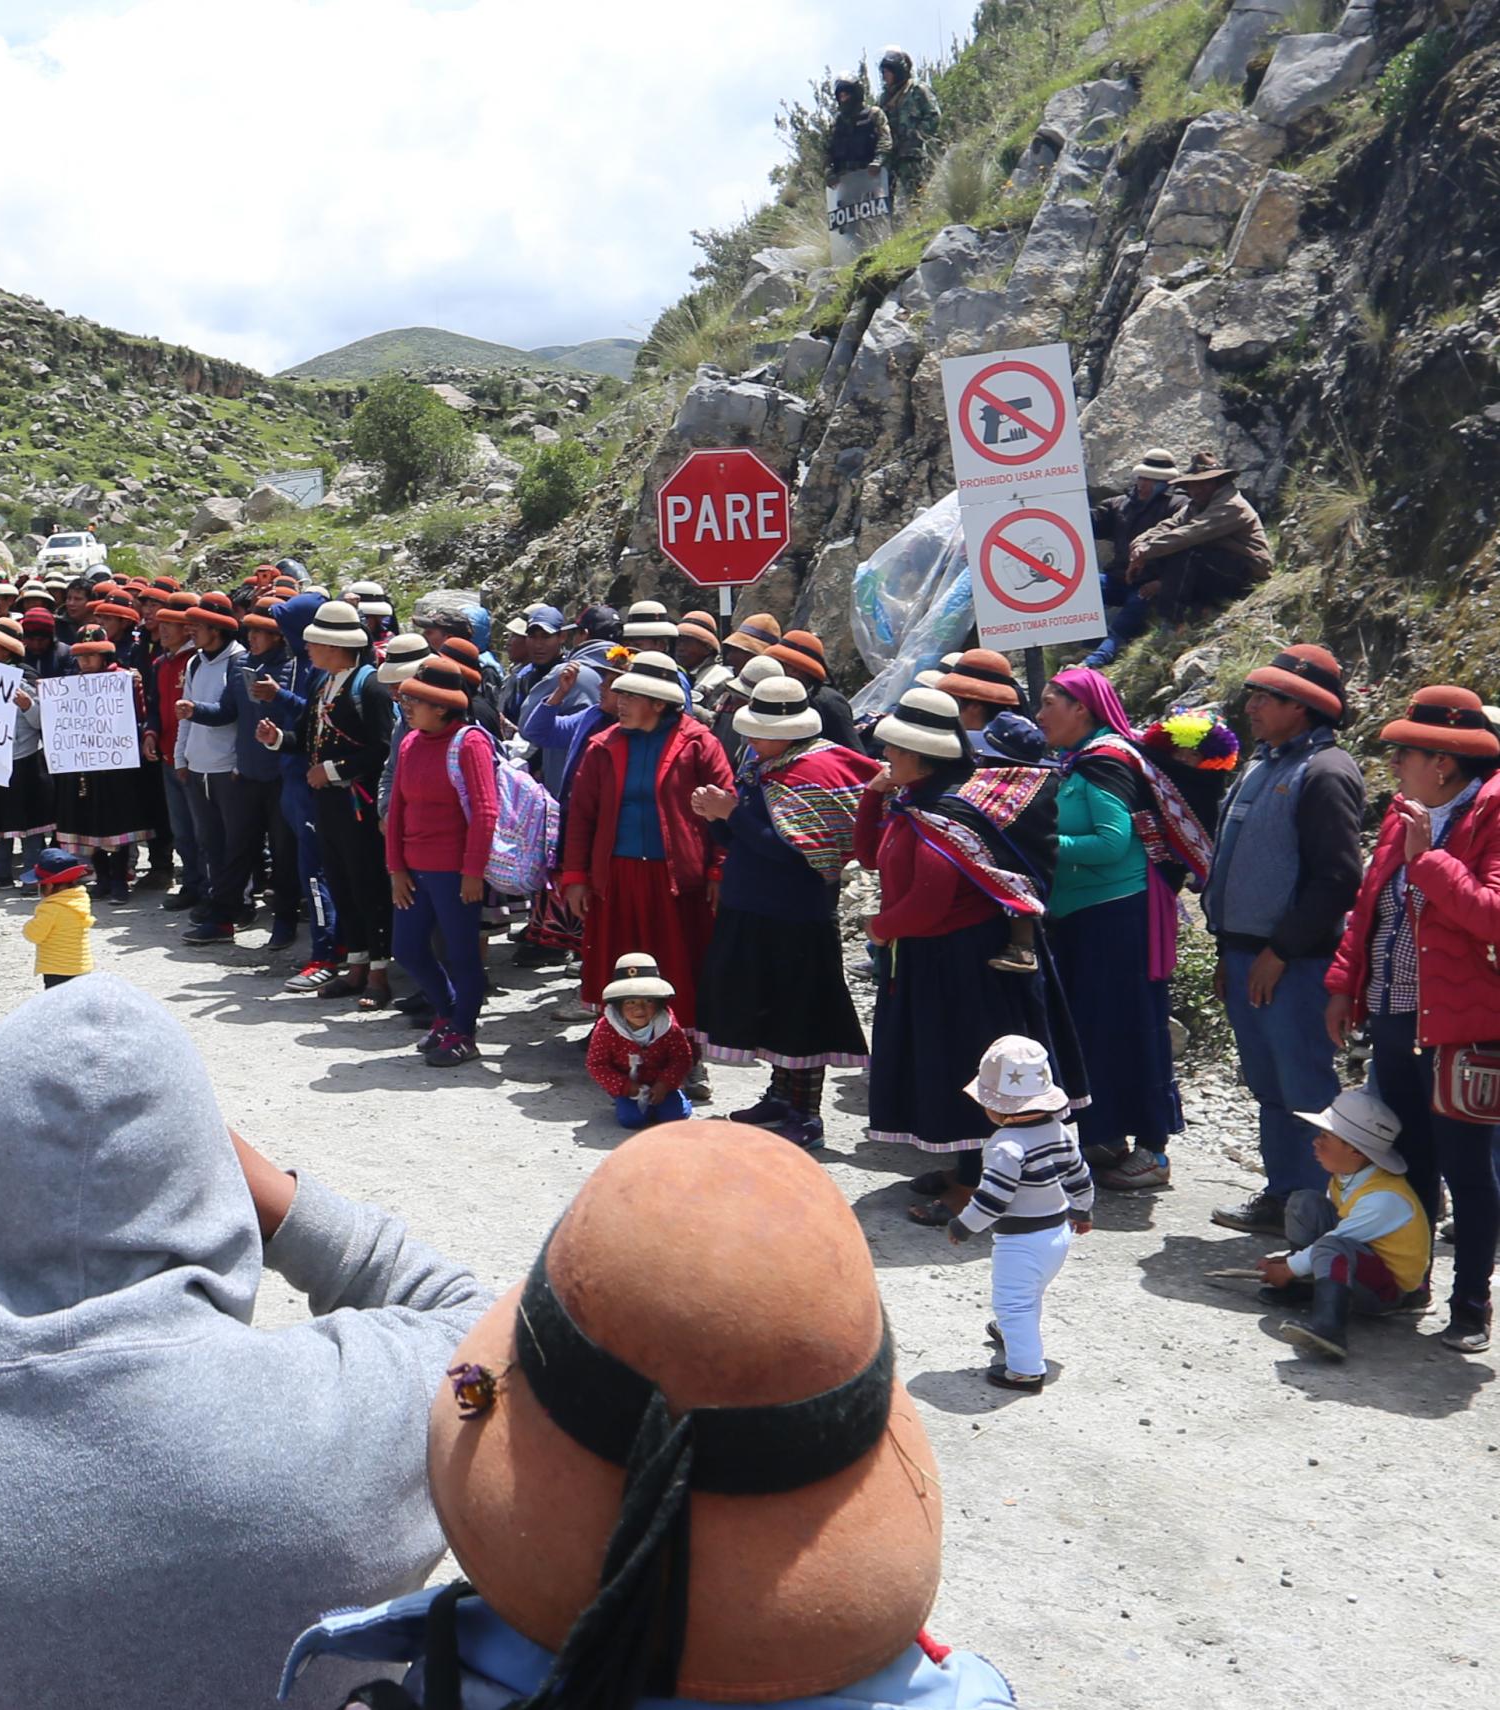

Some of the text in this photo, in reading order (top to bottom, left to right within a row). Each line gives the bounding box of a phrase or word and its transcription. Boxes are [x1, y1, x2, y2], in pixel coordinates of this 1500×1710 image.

[828, 198, 889, 230] POLICIA
[959, 464, 1079, 489] PROHIBIDO USAR ARMAS
[666, 491, 782, 544] PARE
[980, 612, 1100, 636] PROHIBIDO TOMAR FOTOGRAFIAS
[41, 677, 69, 699] NOS
[52, 696, 125, 717] TANTO QUE
[55, 716, 113, 734] ACABARON
[74, 750, 124, 768] MIEDO
